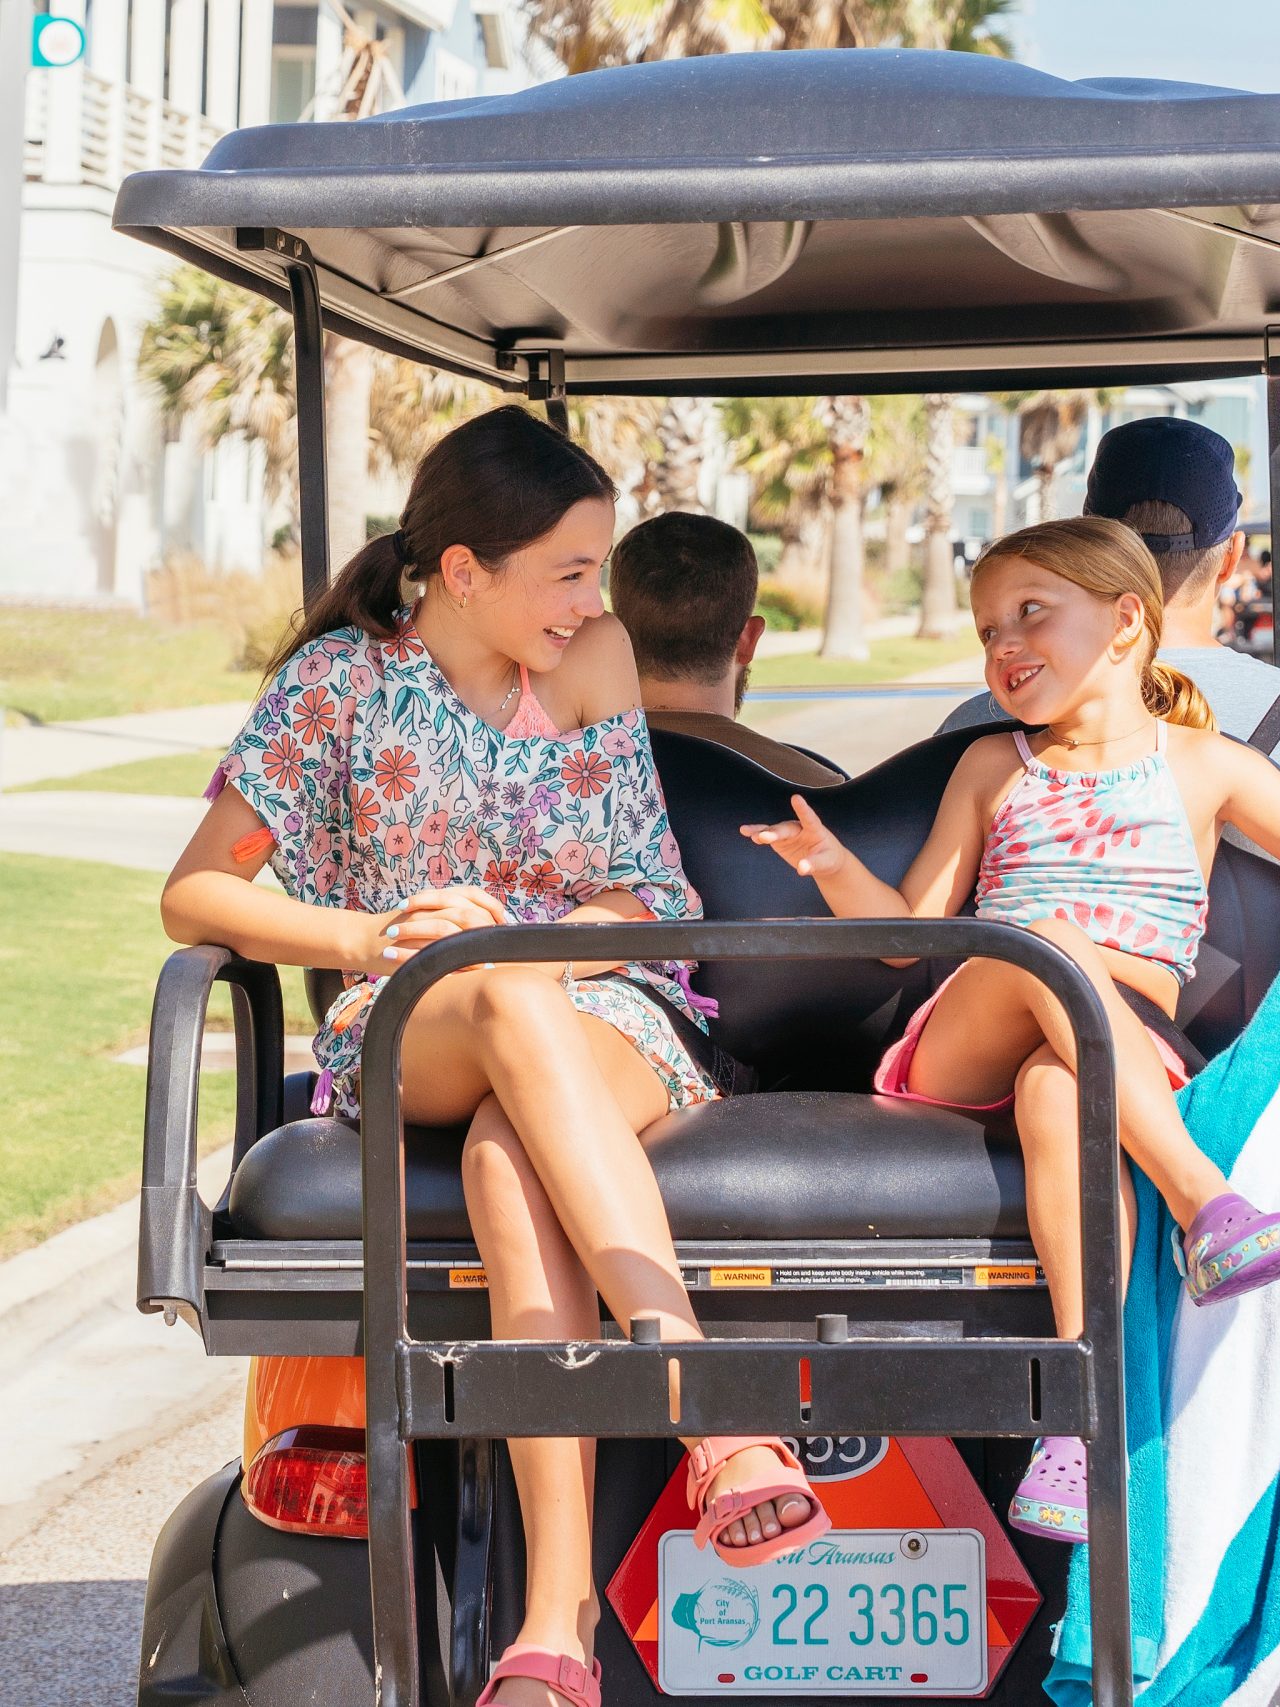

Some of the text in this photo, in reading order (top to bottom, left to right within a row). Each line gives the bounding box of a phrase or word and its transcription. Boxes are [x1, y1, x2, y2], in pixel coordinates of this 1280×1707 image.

[723, 1273, 765, 1281] WARNING
[780, 1269, 792, 1277] Hold
[793, 1269, 800, 1277] on
[801, 1269, 811, 1277] and
[812, 1269, 825, 1278] keep
[826, 1269, 840, 1277] entire
[841, 1269, 855, 1278] body
[855, 1269, 871, 1277] inside
[872, 1269, 891, 1277] vehicle
[891, 1269, 905, 1277] while
[988, 1272, 1030, 1280] WARNING
[463, 1274, 488, 1283] WARN
[780, 1436, 866, 1463] 55
[808, 1541, 896, 1566] Aransas
[715, 1600, 730, 1608] City
[719, 1609, 727, 1617] of
[772, 1583, 970, 1646] 22 3365
[743, 1666, 903, 1681] GOLF CART
